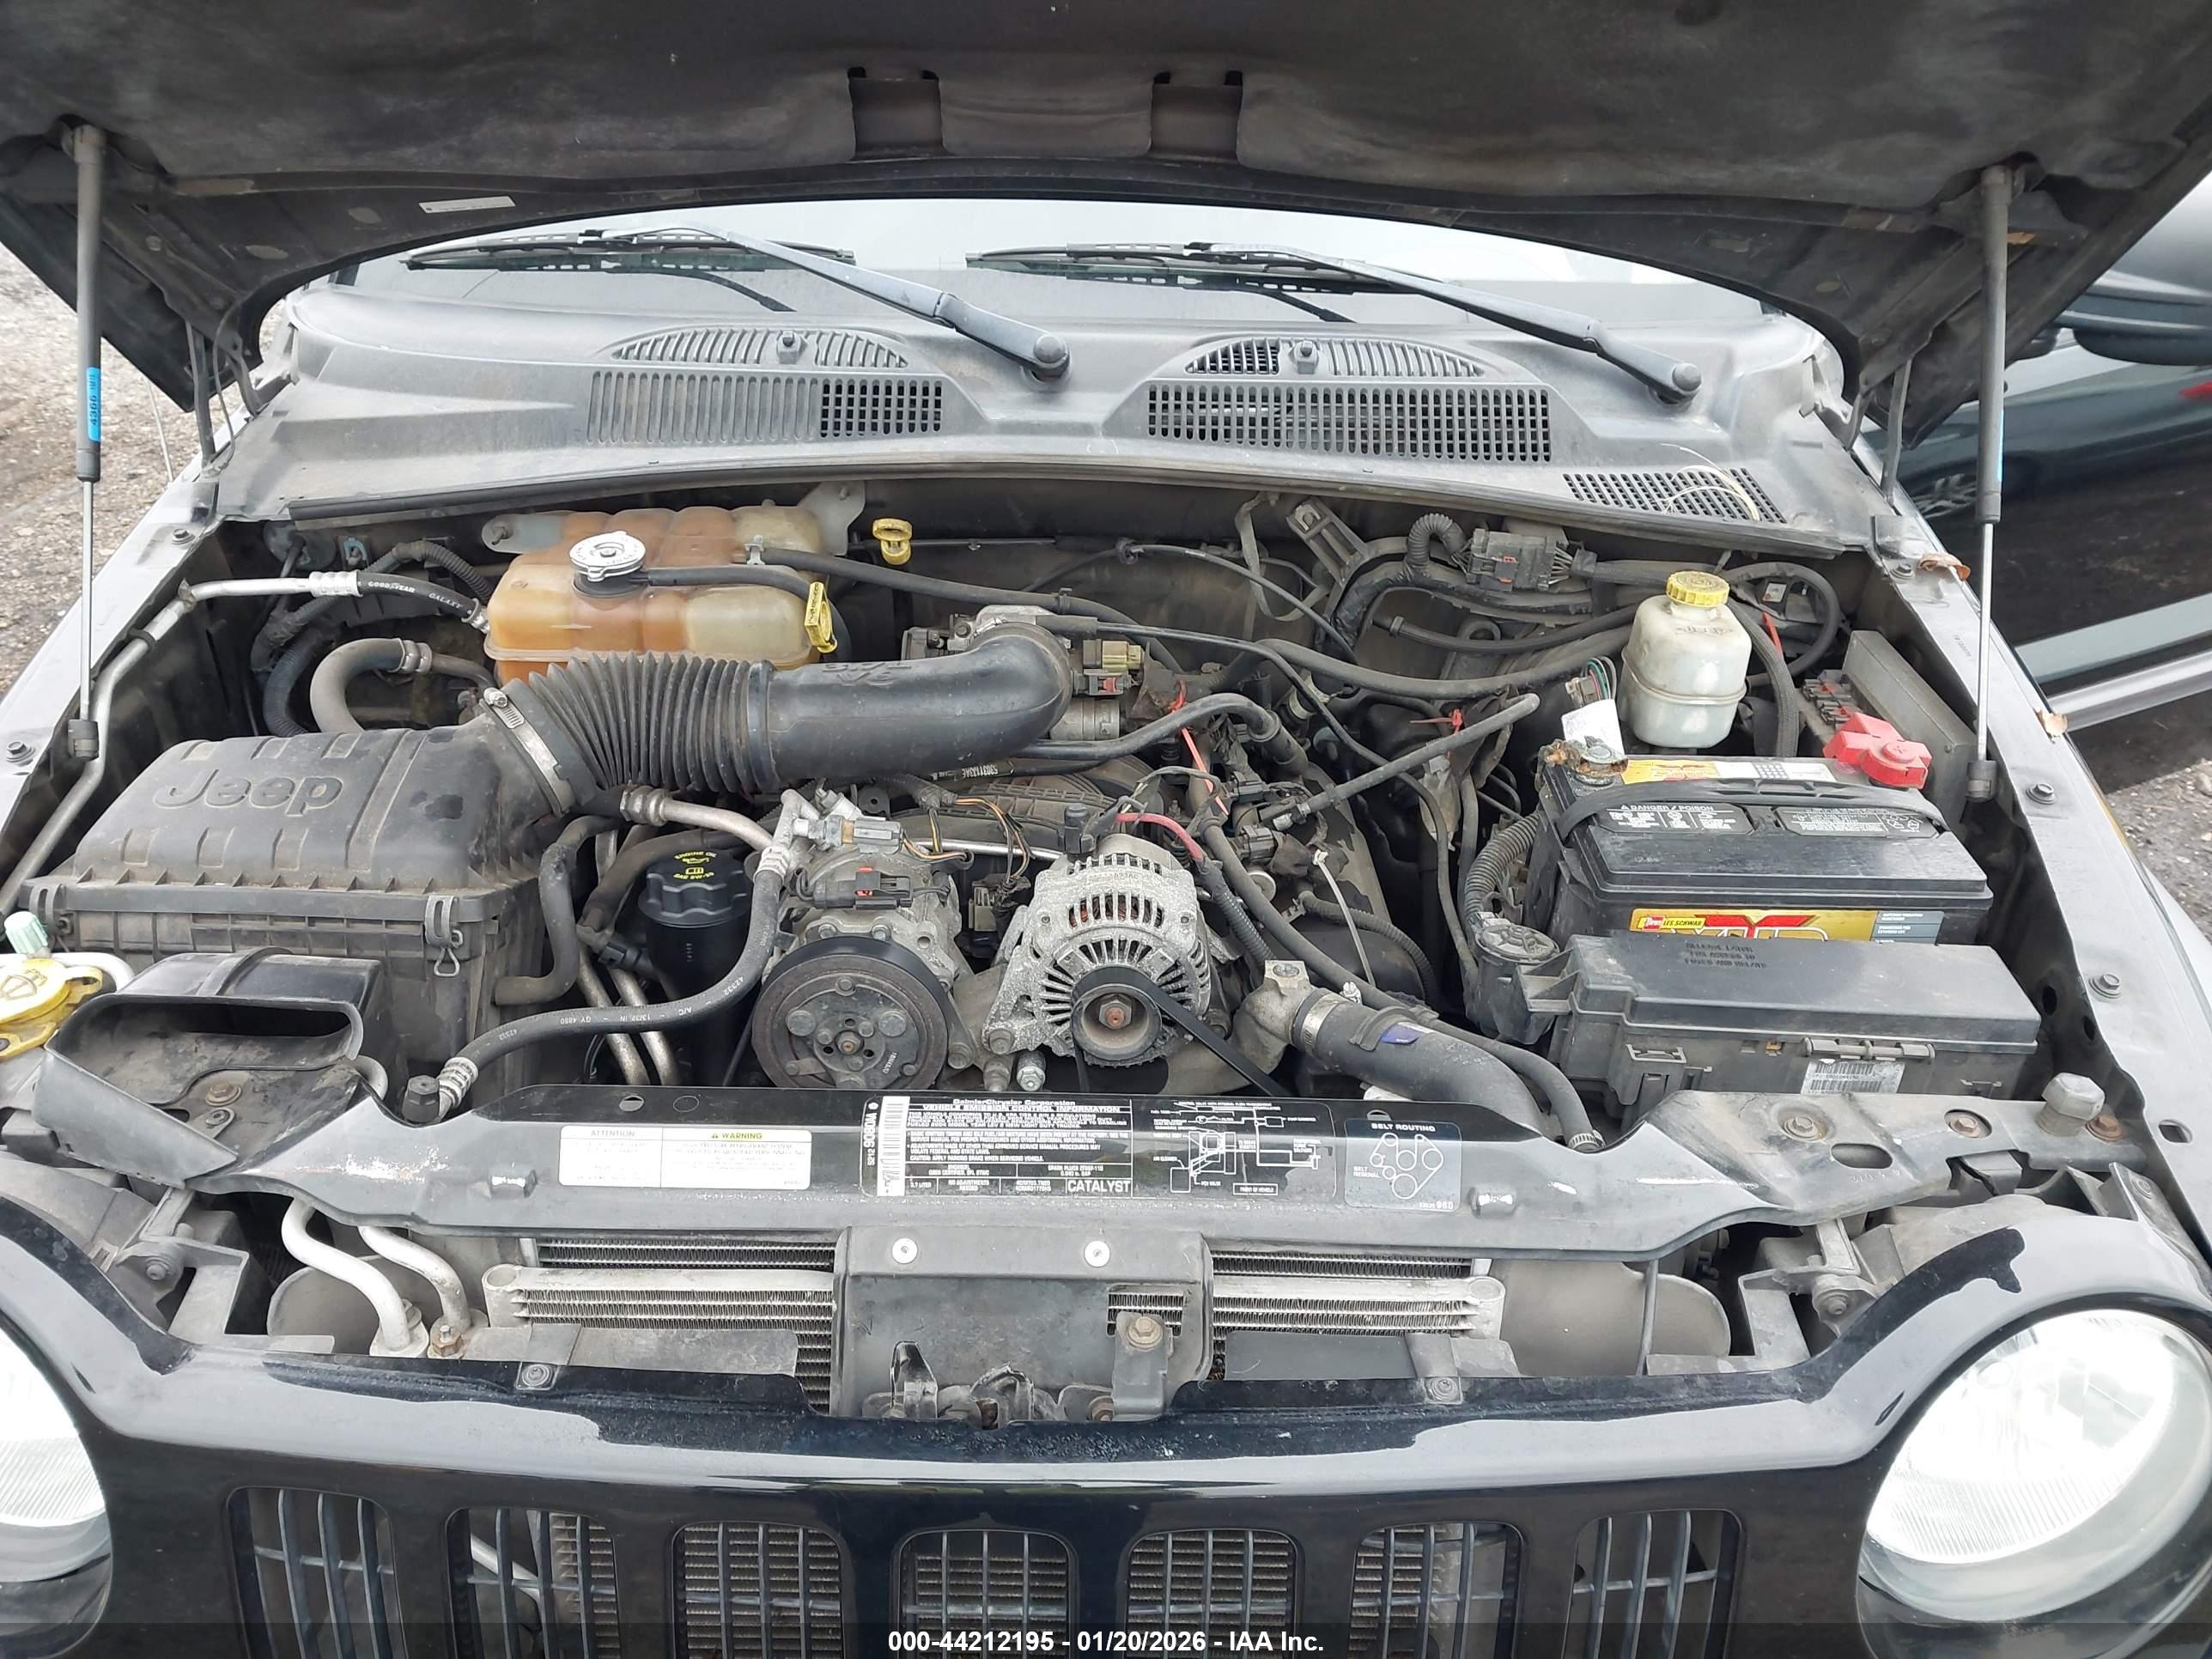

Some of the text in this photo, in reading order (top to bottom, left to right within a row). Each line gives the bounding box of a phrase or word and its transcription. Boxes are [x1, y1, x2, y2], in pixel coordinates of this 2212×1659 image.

[368, 580, 464, 609] GOODYEAR GALAXY
[153, 767, 344, 818] Jeep
[678, 1006, 692, 1017] A/C
[580, 1016, 592, 1024] GY
[620, 1015, 629, 1024] IN
[1395, 1123, 1437, 1132] ROUTING
[1067, 1179, 1132, 1194] CATALYST
